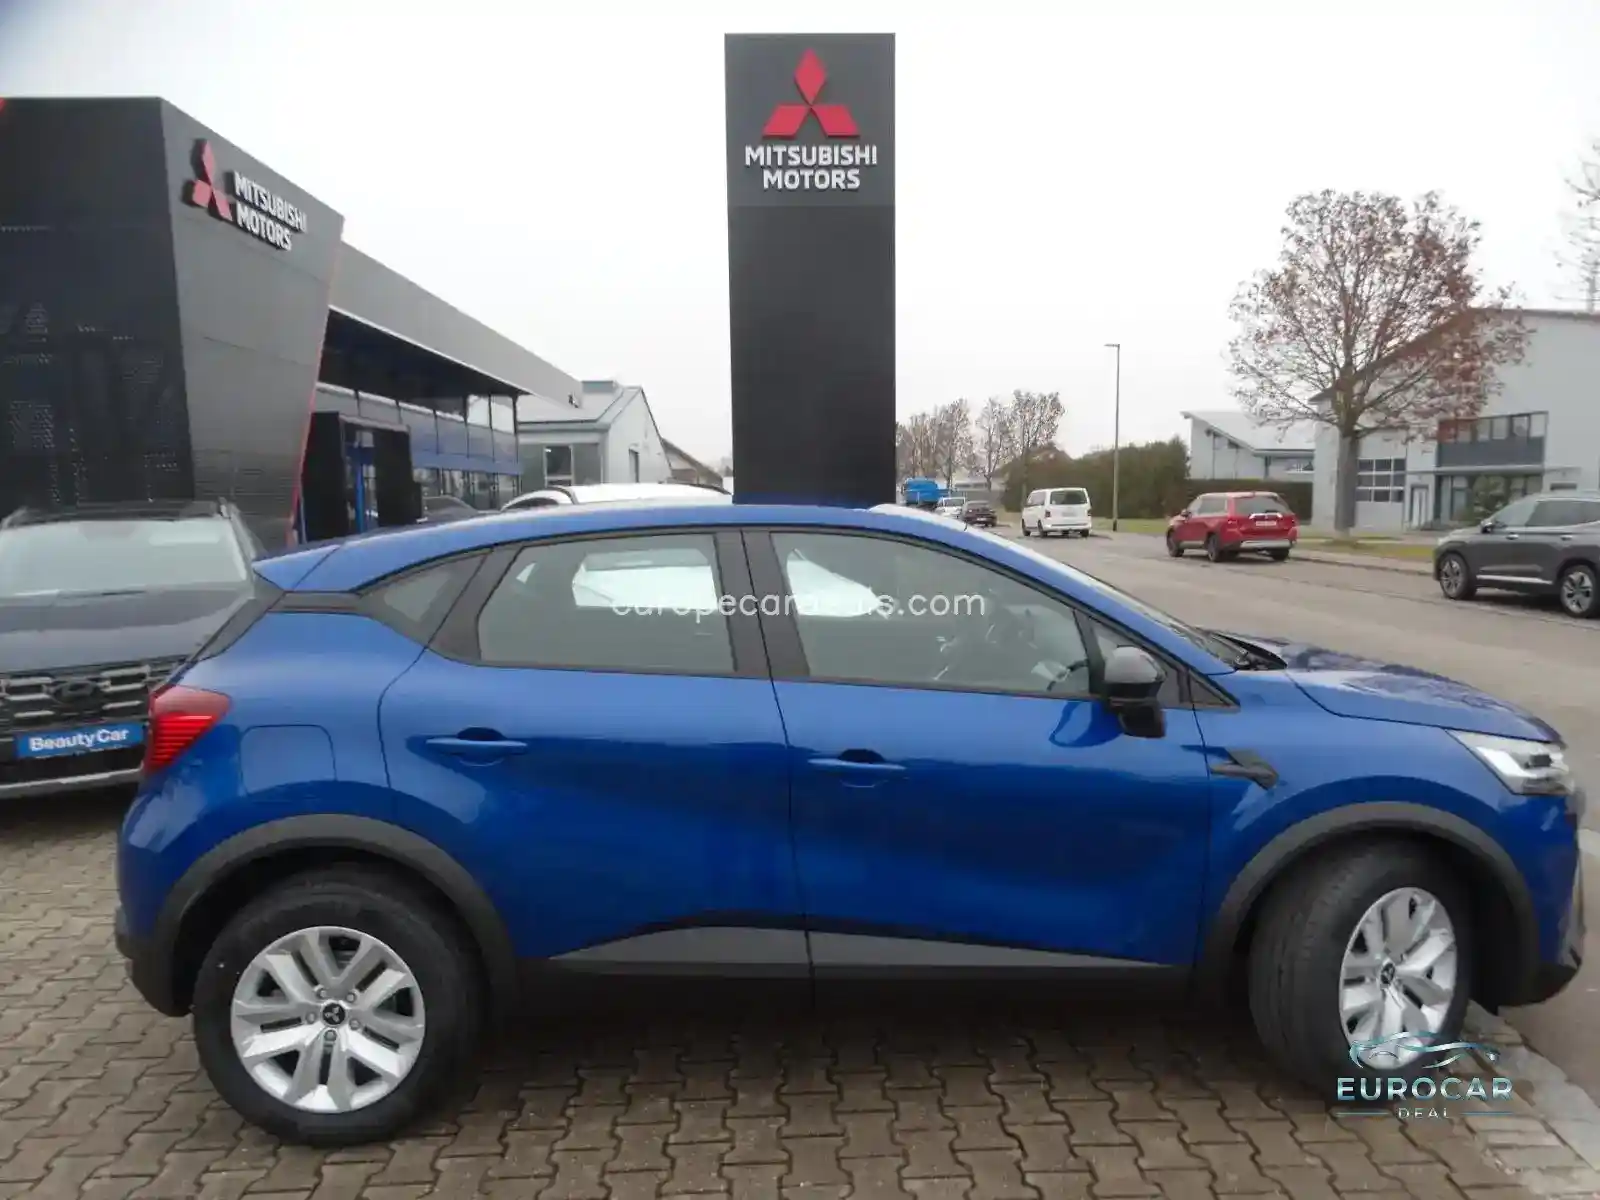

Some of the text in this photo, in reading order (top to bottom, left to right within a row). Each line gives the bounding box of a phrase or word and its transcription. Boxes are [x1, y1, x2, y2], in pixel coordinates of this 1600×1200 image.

[745, 144, 877, 166] MITSUBISHI
[763, 169, 861, 190] MOTORS
[233, 170, 307, 234] MITSUBISHI
[236, 200, 292, 251] MOTORS
